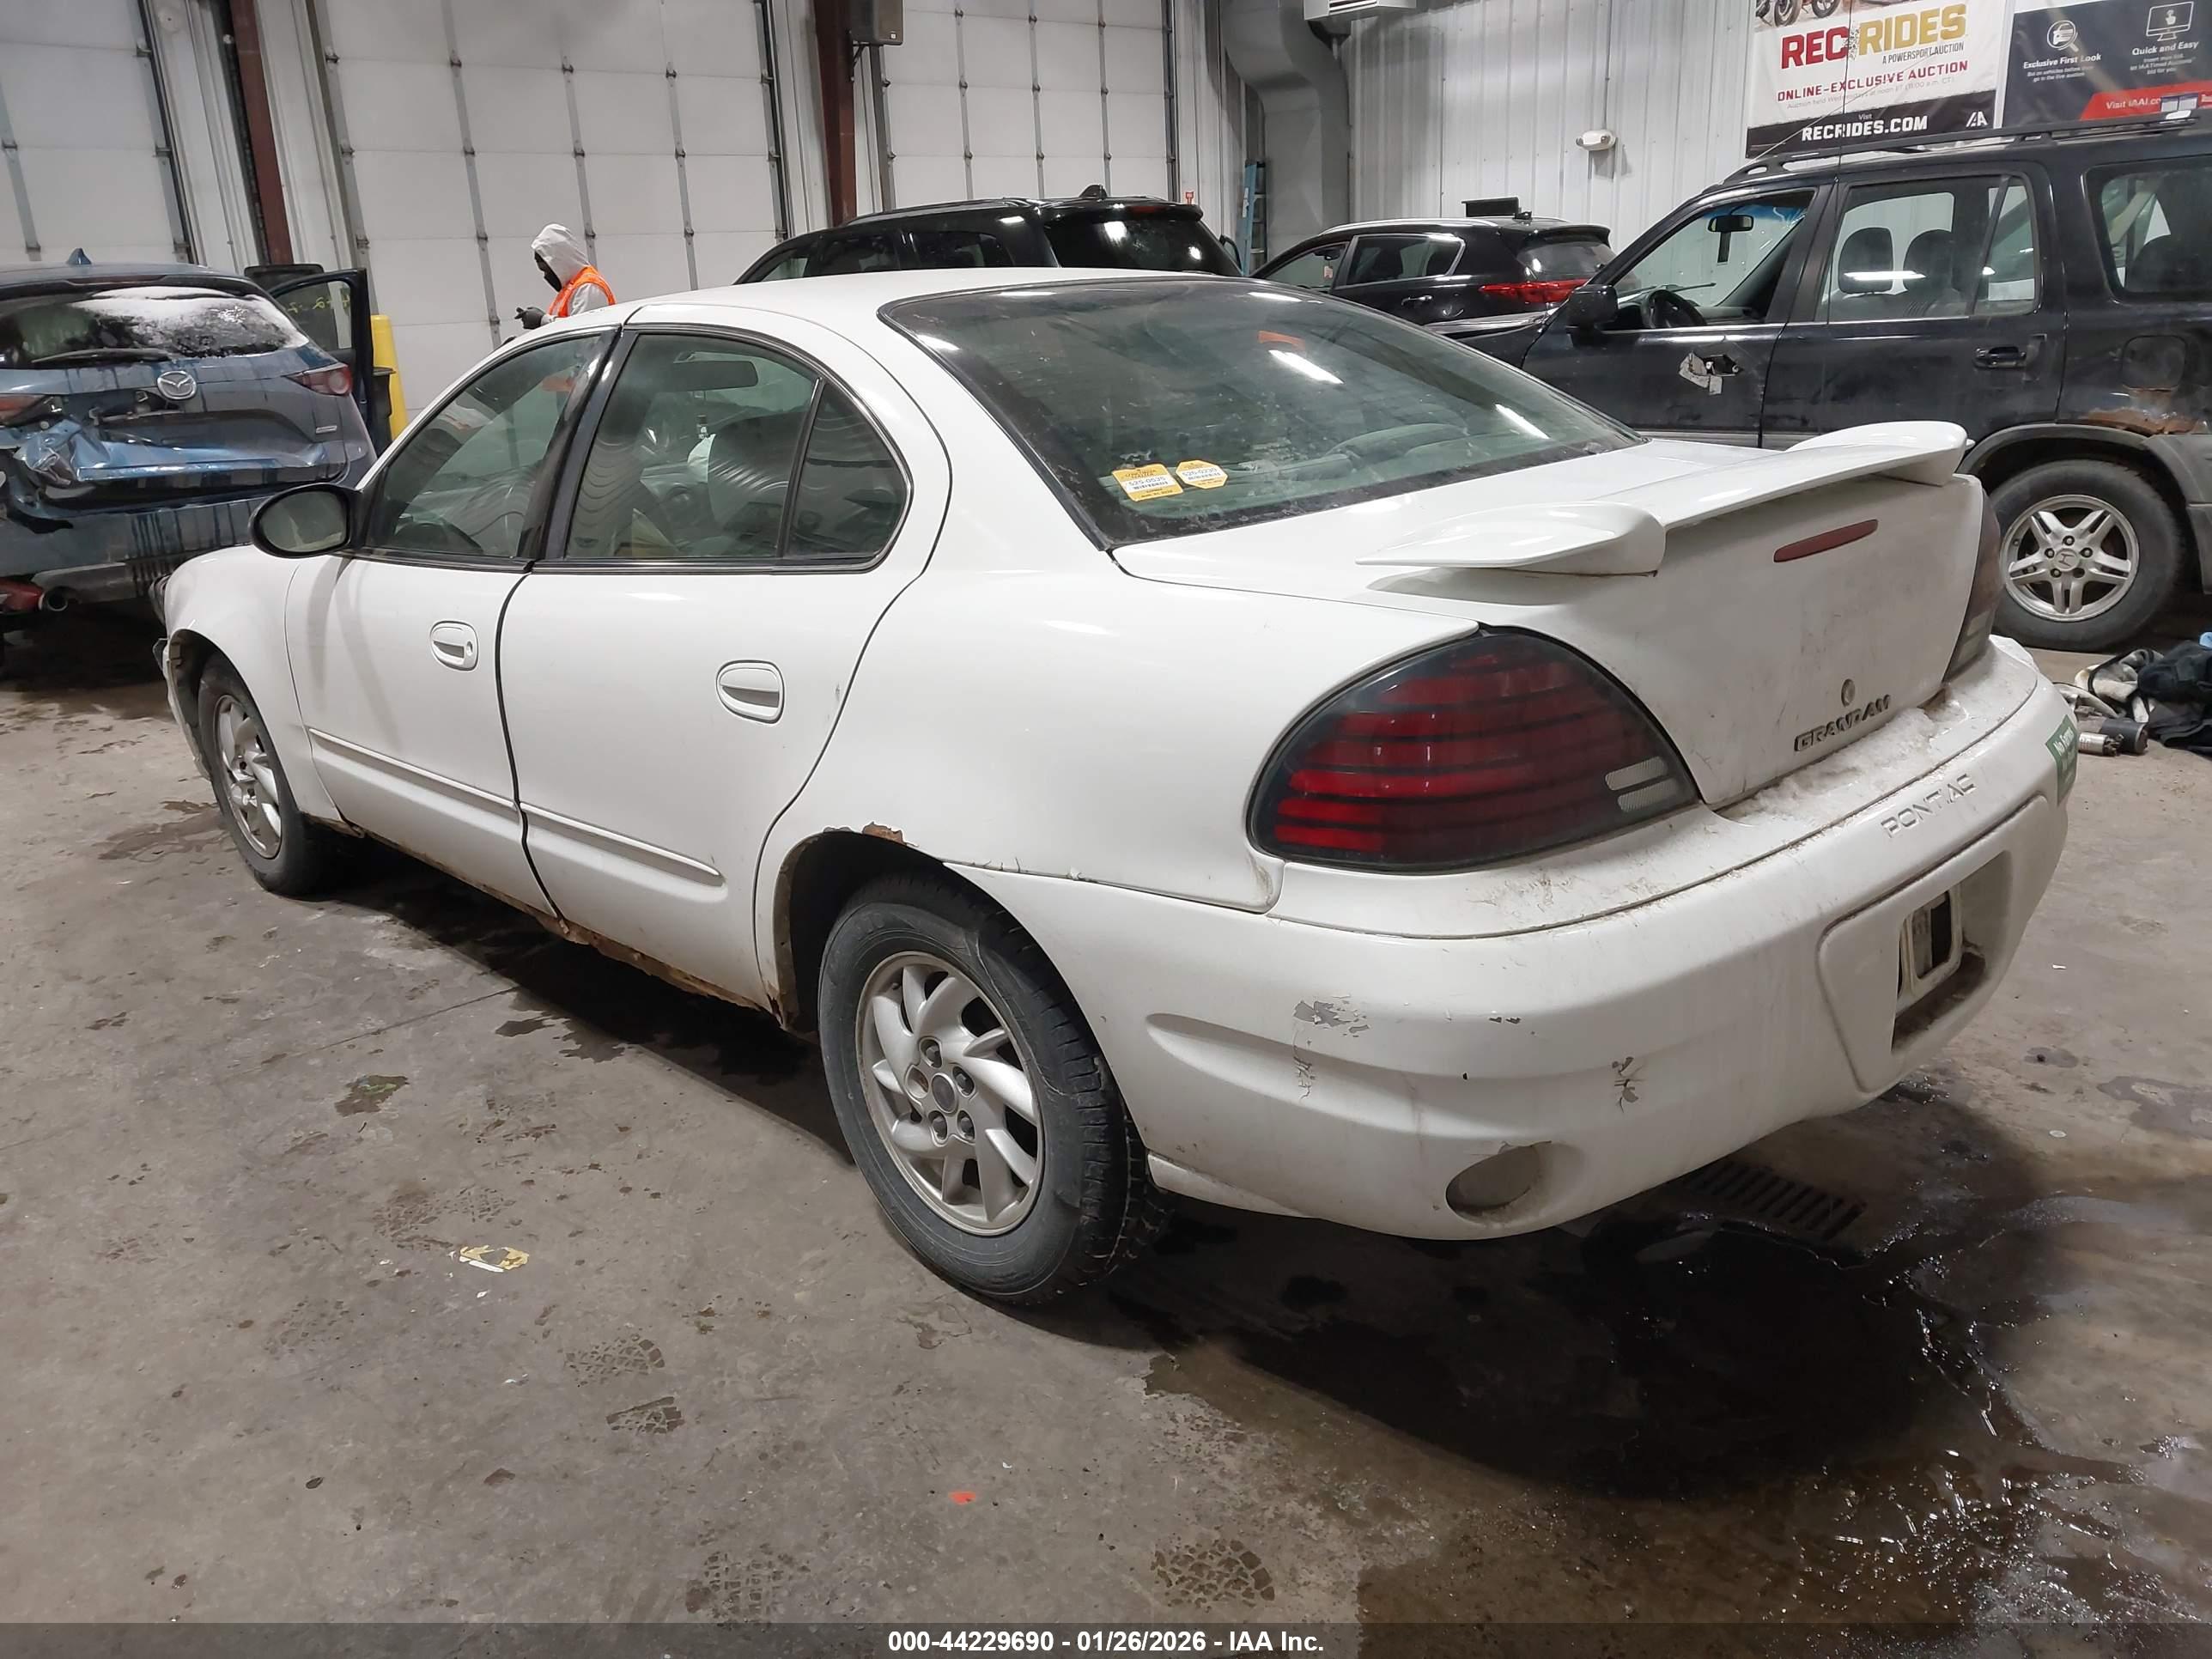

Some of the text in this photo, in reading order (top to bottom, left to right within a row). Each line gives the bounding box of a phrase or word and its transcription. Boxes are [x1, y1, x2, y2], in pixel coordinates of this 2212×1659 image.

[1781, 3, 1967, 70] REC RIDES
[1882, 56, 1887, 64] A
[1933, 41, 1965, 56] AUCTION
[2132, 40, 2199, 55] Quick and Easy
[2023, 52, 2102, 69] Exclusive First Look
[1778, 60, 1968, 102] ONLINE-EXCLUSIVE AUCTION
[2106, 100, 2126, 110] Visit
[1858, 112, 1872, 121] Visit
[1802, 115, 1928, 142] RECRIDES.COM
